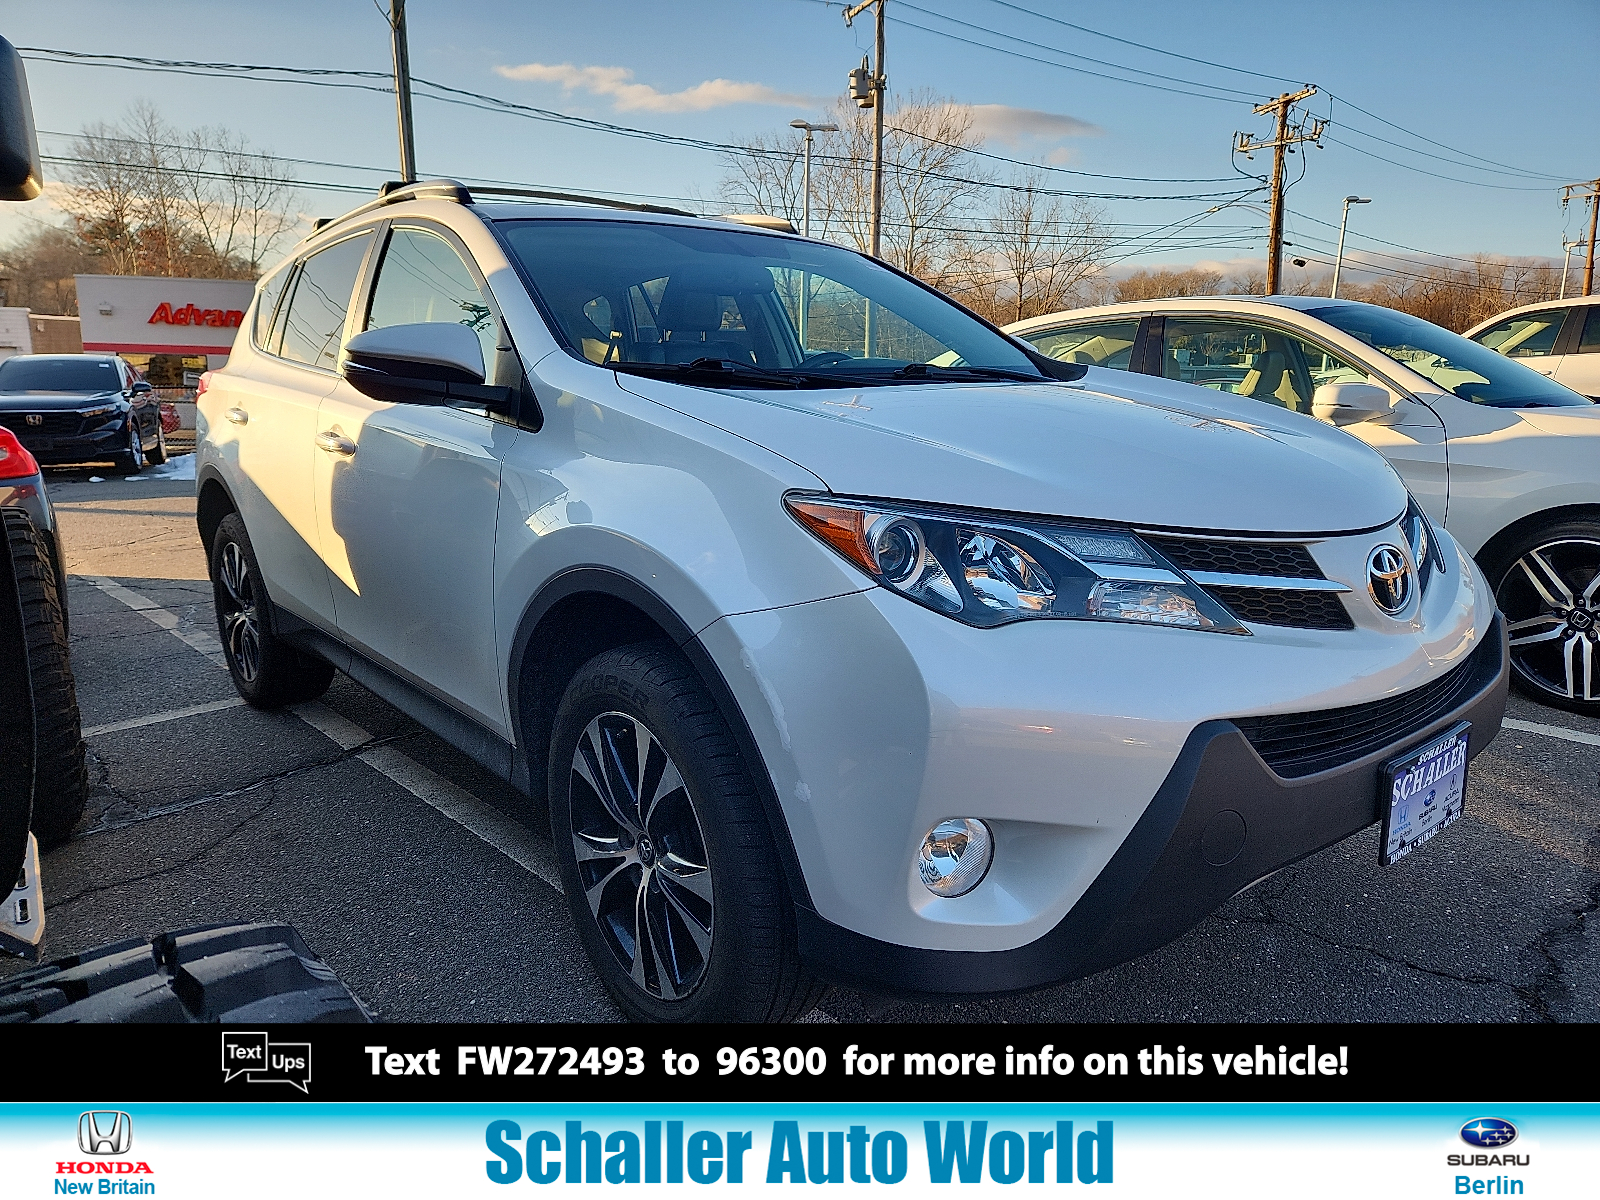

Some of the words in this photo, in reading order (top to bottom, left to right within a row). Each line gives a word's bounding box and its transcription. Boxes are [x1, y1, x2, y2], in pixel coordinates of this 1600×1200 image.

[1418, 735, 1457, 765] SCHALLER
[1391, 741, 1467, 807] SCHALLER
[1418, 804, 1438, 820] SUBARU
[1392, 821, 1412, 836] HONDA
[1390, 843, 1413, 865] HONDA
